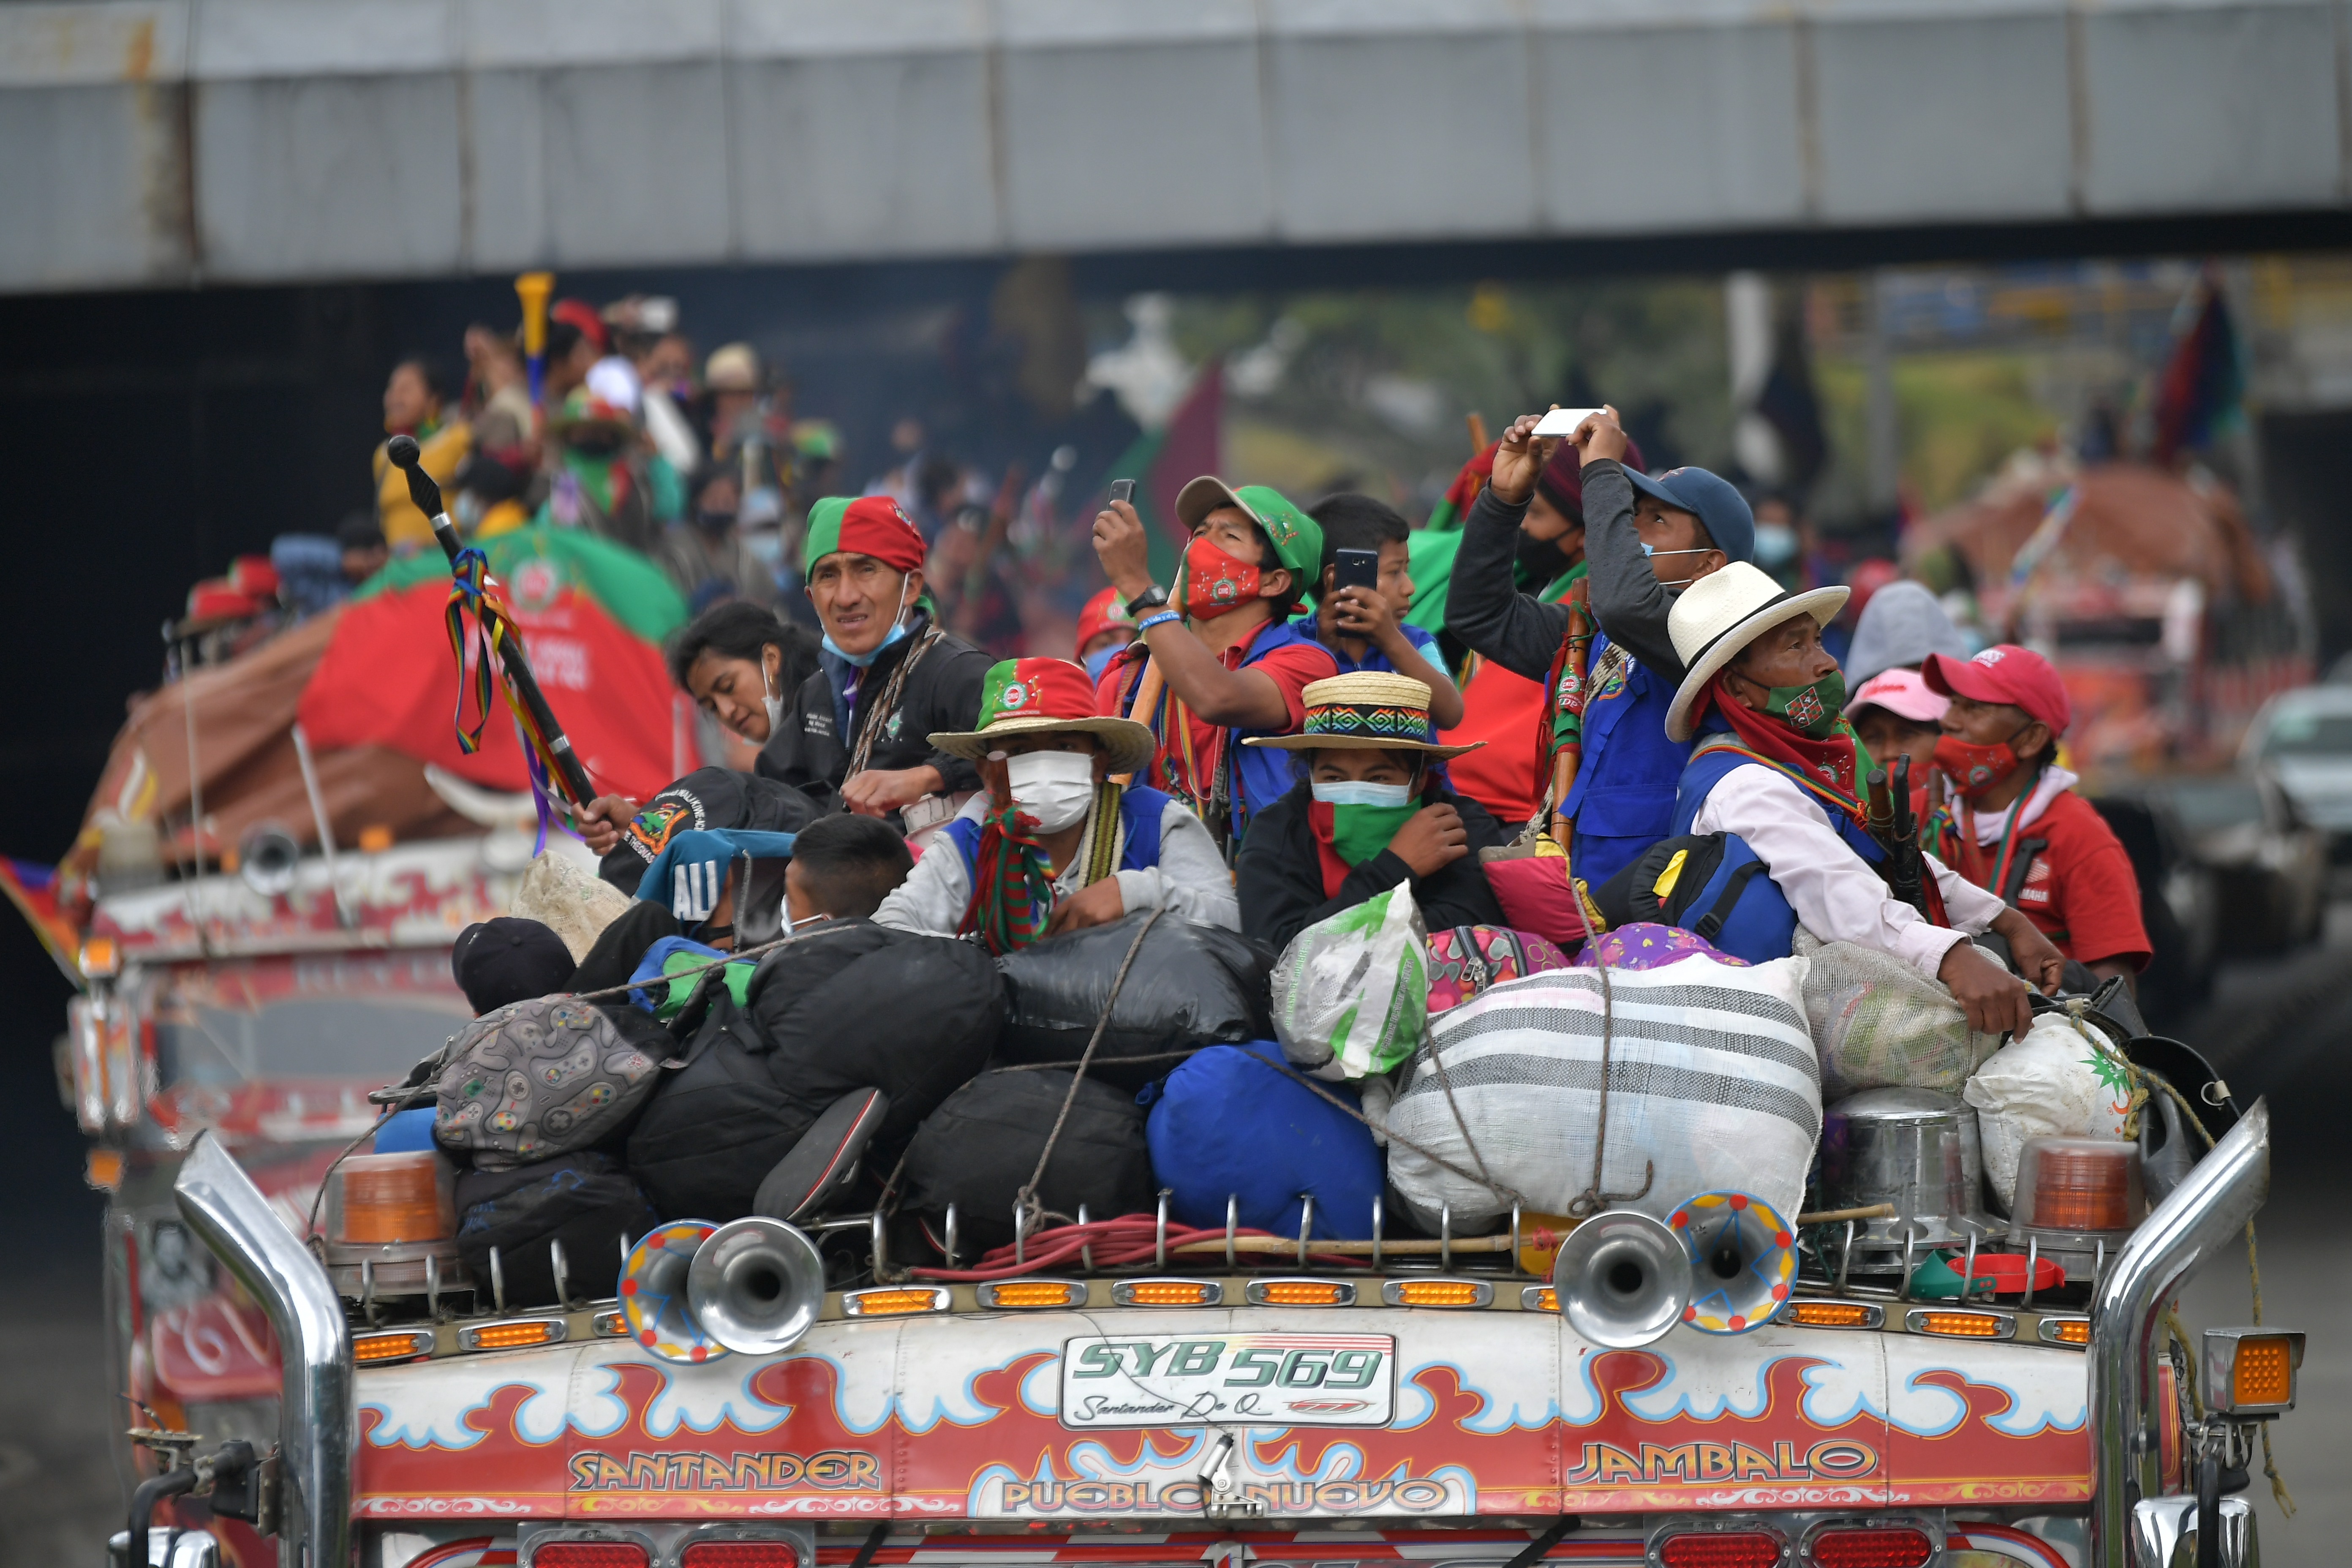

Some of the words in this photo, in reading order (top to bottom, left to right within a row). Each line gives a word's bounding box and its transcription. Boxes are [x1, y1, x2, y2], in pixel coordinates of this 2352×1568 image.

[2018, 888, 2048, 903] MAHA
[1293, 947, 1308, 977] HOMBRE
[1289, 979, 1298, 990] DE
[1286, 992, 1297, 1015] JEANS
[1072, 1341, 1227, 1379] SYB
[1223, 1348, 1383, 1389] 569
[1074, 1395, 1174, 1420] Santander
[1181, 1391, 1226, 1420] De
[567, 1449, 881, 1492] SANTANDER
[1567, 1438, 1878, 1484] JAMBALO
[1003, 1481, 1212, 1514] PUEBLO
[1243, 1477, 1450, 1514] NUEVO
